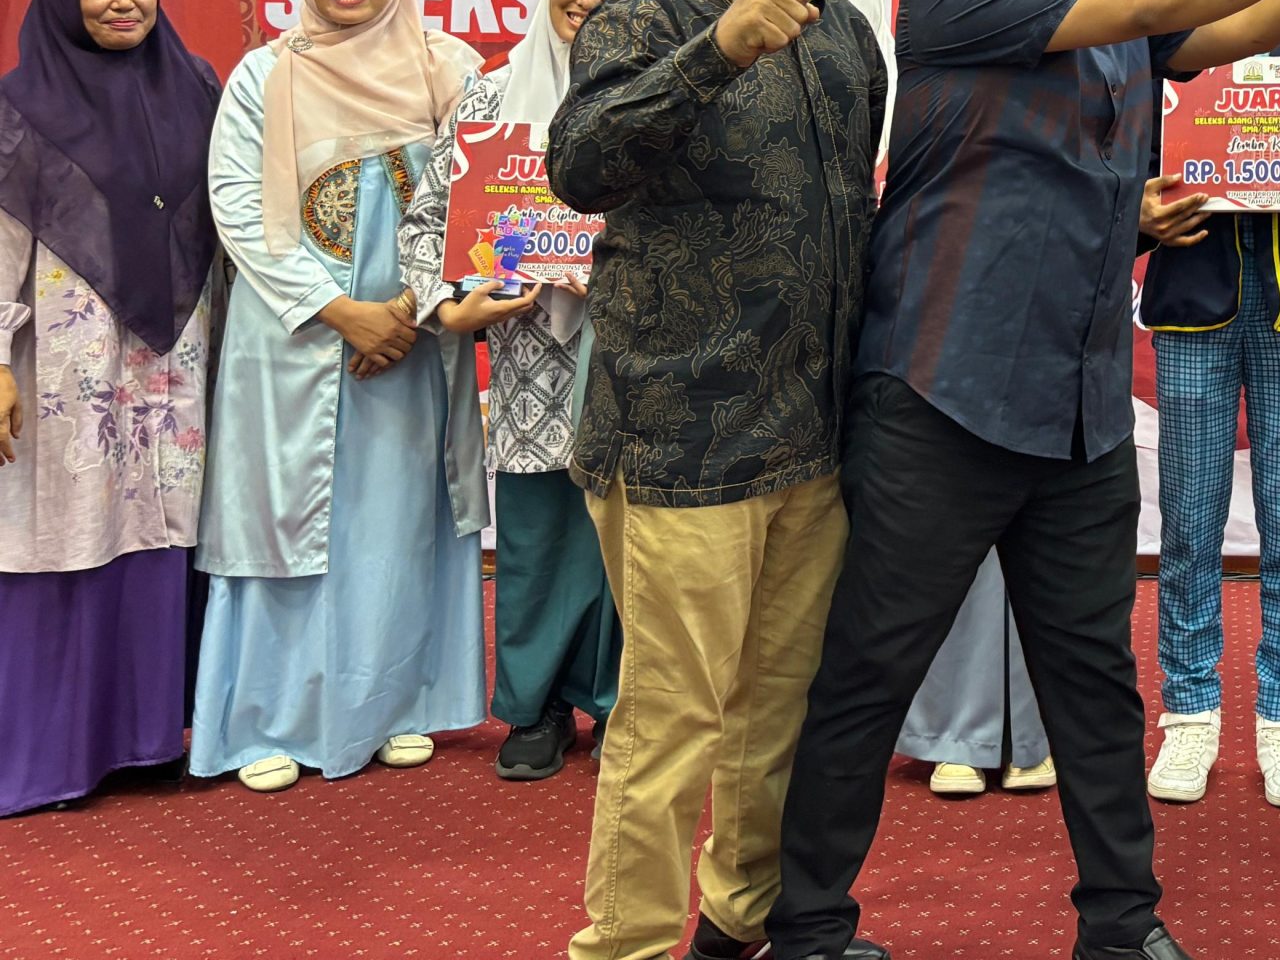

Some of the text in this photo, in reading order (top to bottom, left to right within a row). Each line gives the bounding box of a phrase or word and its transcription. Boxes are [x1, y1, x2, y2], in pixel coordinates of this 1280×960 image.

[1194, 117, 1225, 125] SELEKSI
[1228, 117, 1253, 125] AJANG
[1229, 136, 1265, 152] Lomba
[1185, 159, 1221, 184] RP.
[484, 185, 547, 195] SELEKSI AJANG
